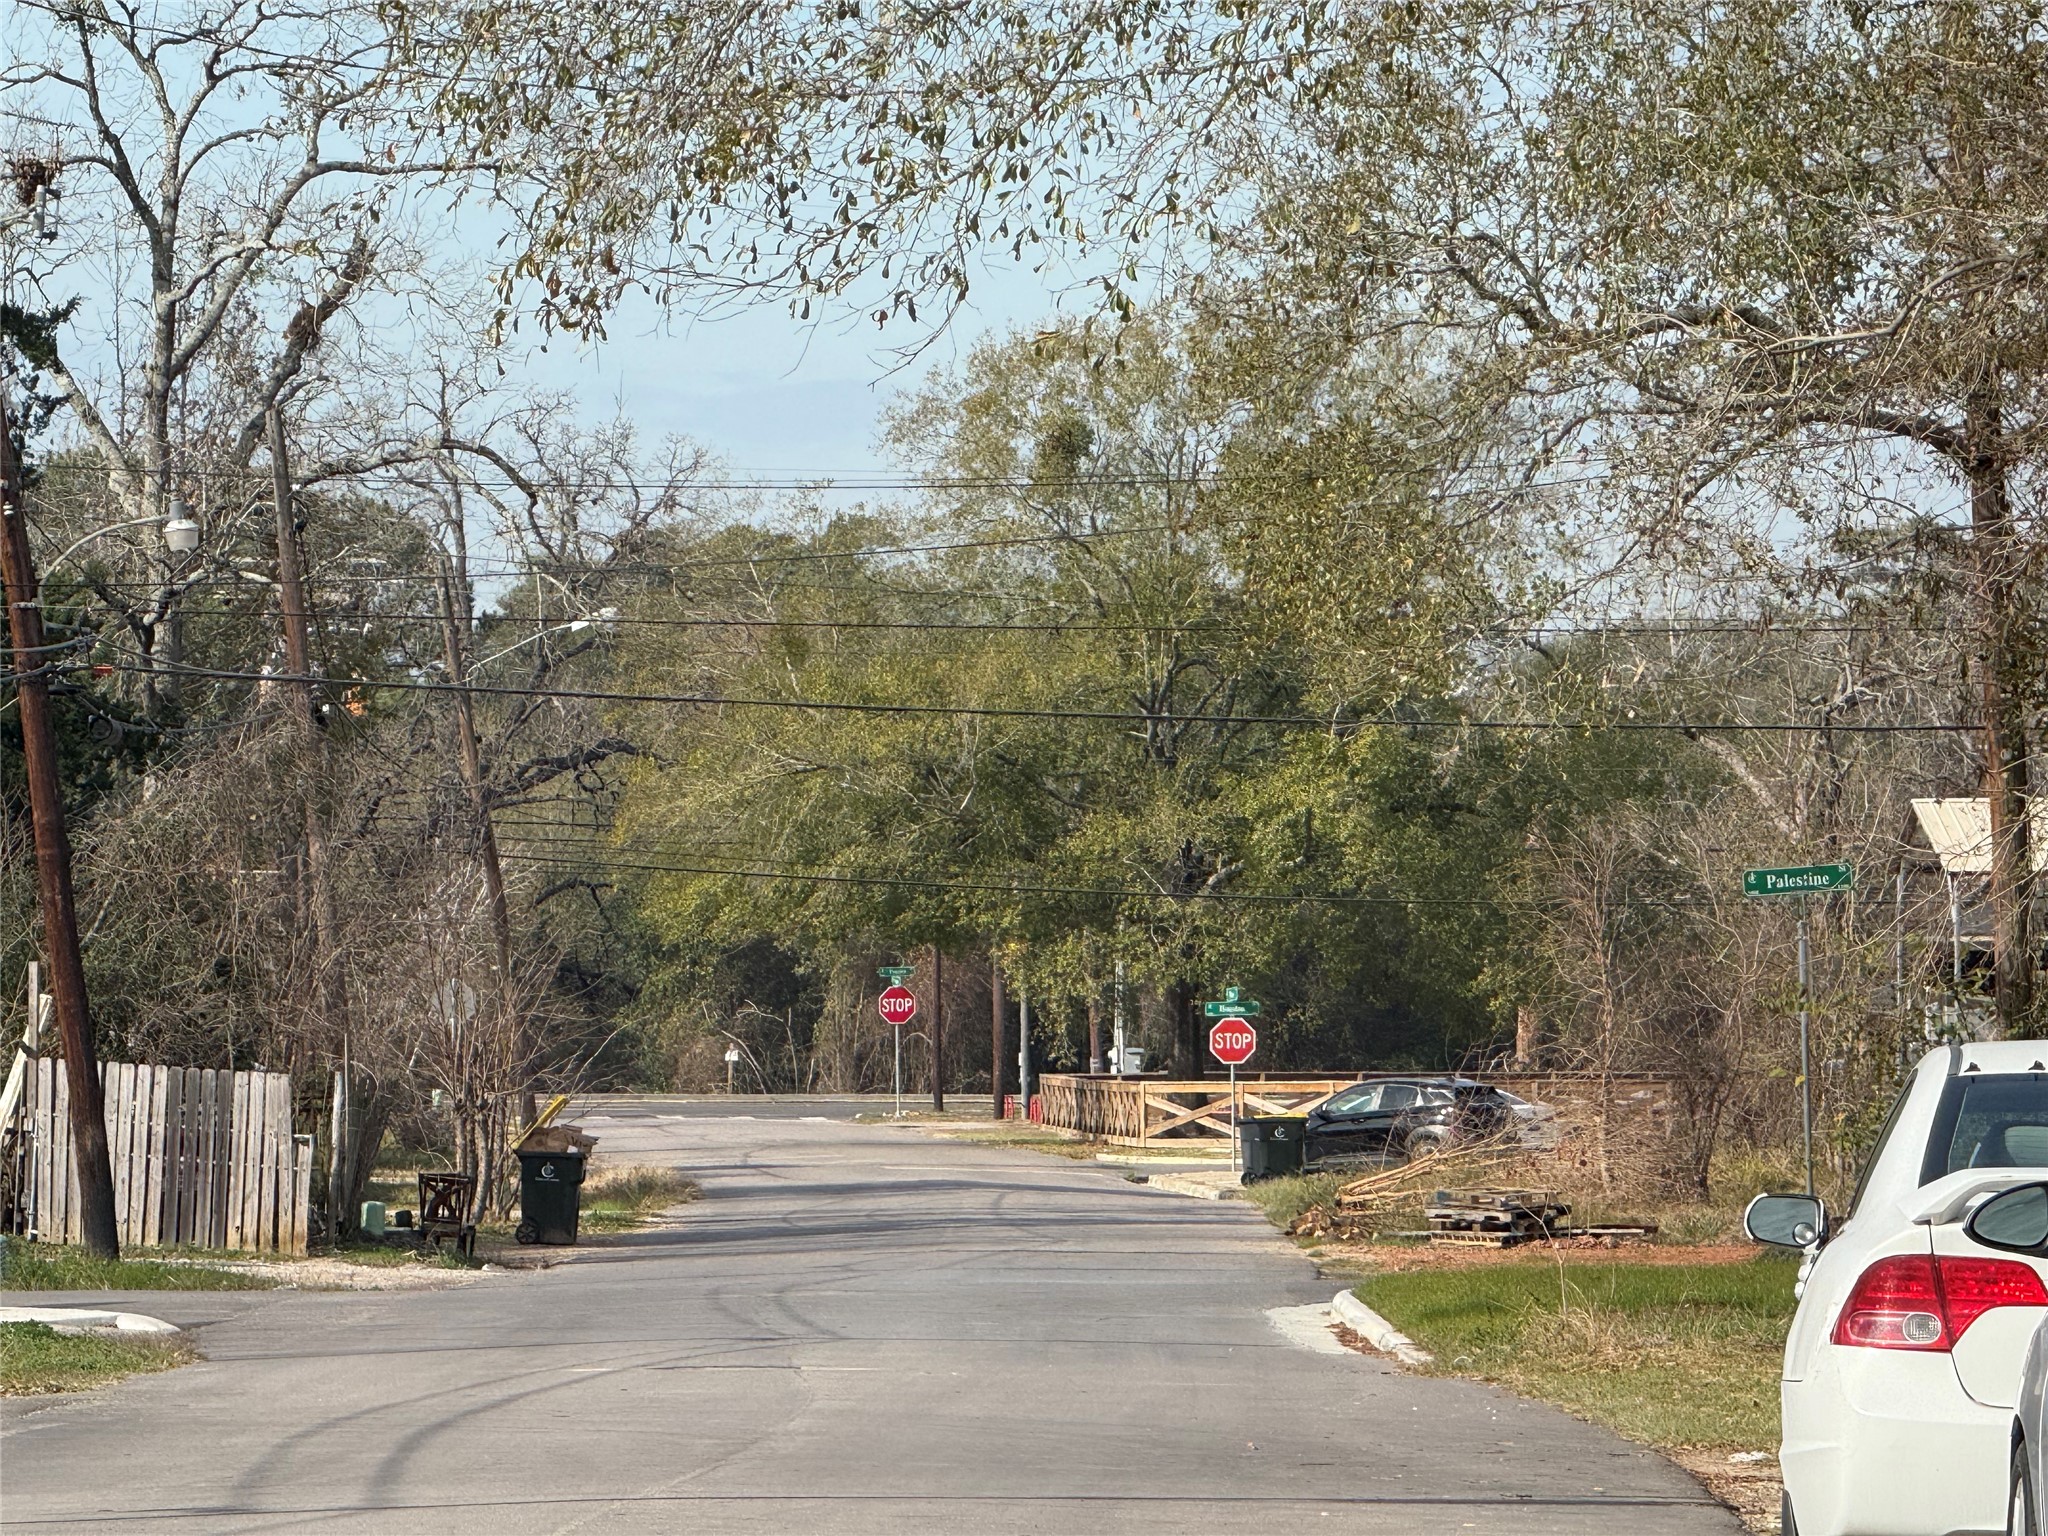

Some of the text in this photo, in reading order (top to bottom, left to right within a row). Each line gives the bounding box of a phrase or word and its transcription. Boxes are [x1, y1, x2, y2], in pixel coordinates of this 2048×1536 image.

[1766, 872, 1830, 889] Palestine
[881, 998, 913, 1013] STOP
[1214, 1032, 1252, 1049] STOP
